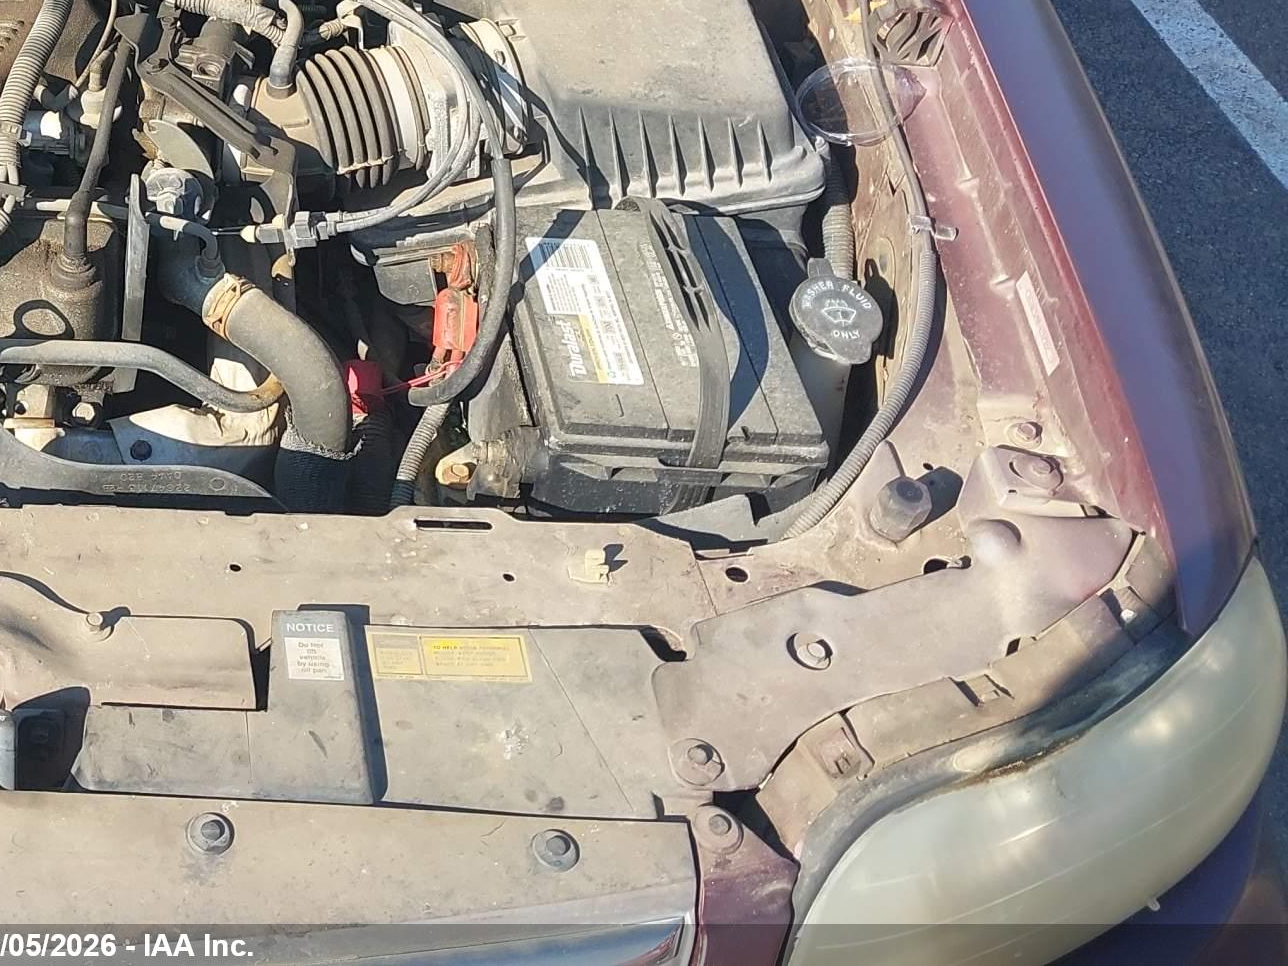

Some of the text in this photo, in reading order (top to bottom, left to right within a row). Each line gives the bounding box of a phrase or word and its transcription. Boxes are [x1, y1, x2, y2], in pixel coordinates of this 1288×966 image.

[841, 284, 872, 309] FLUID
[832, 329, 861, 340] ONLY
[555, 320, 588, 376] Duralast
[286, 623, 335, 633] NOTICE
